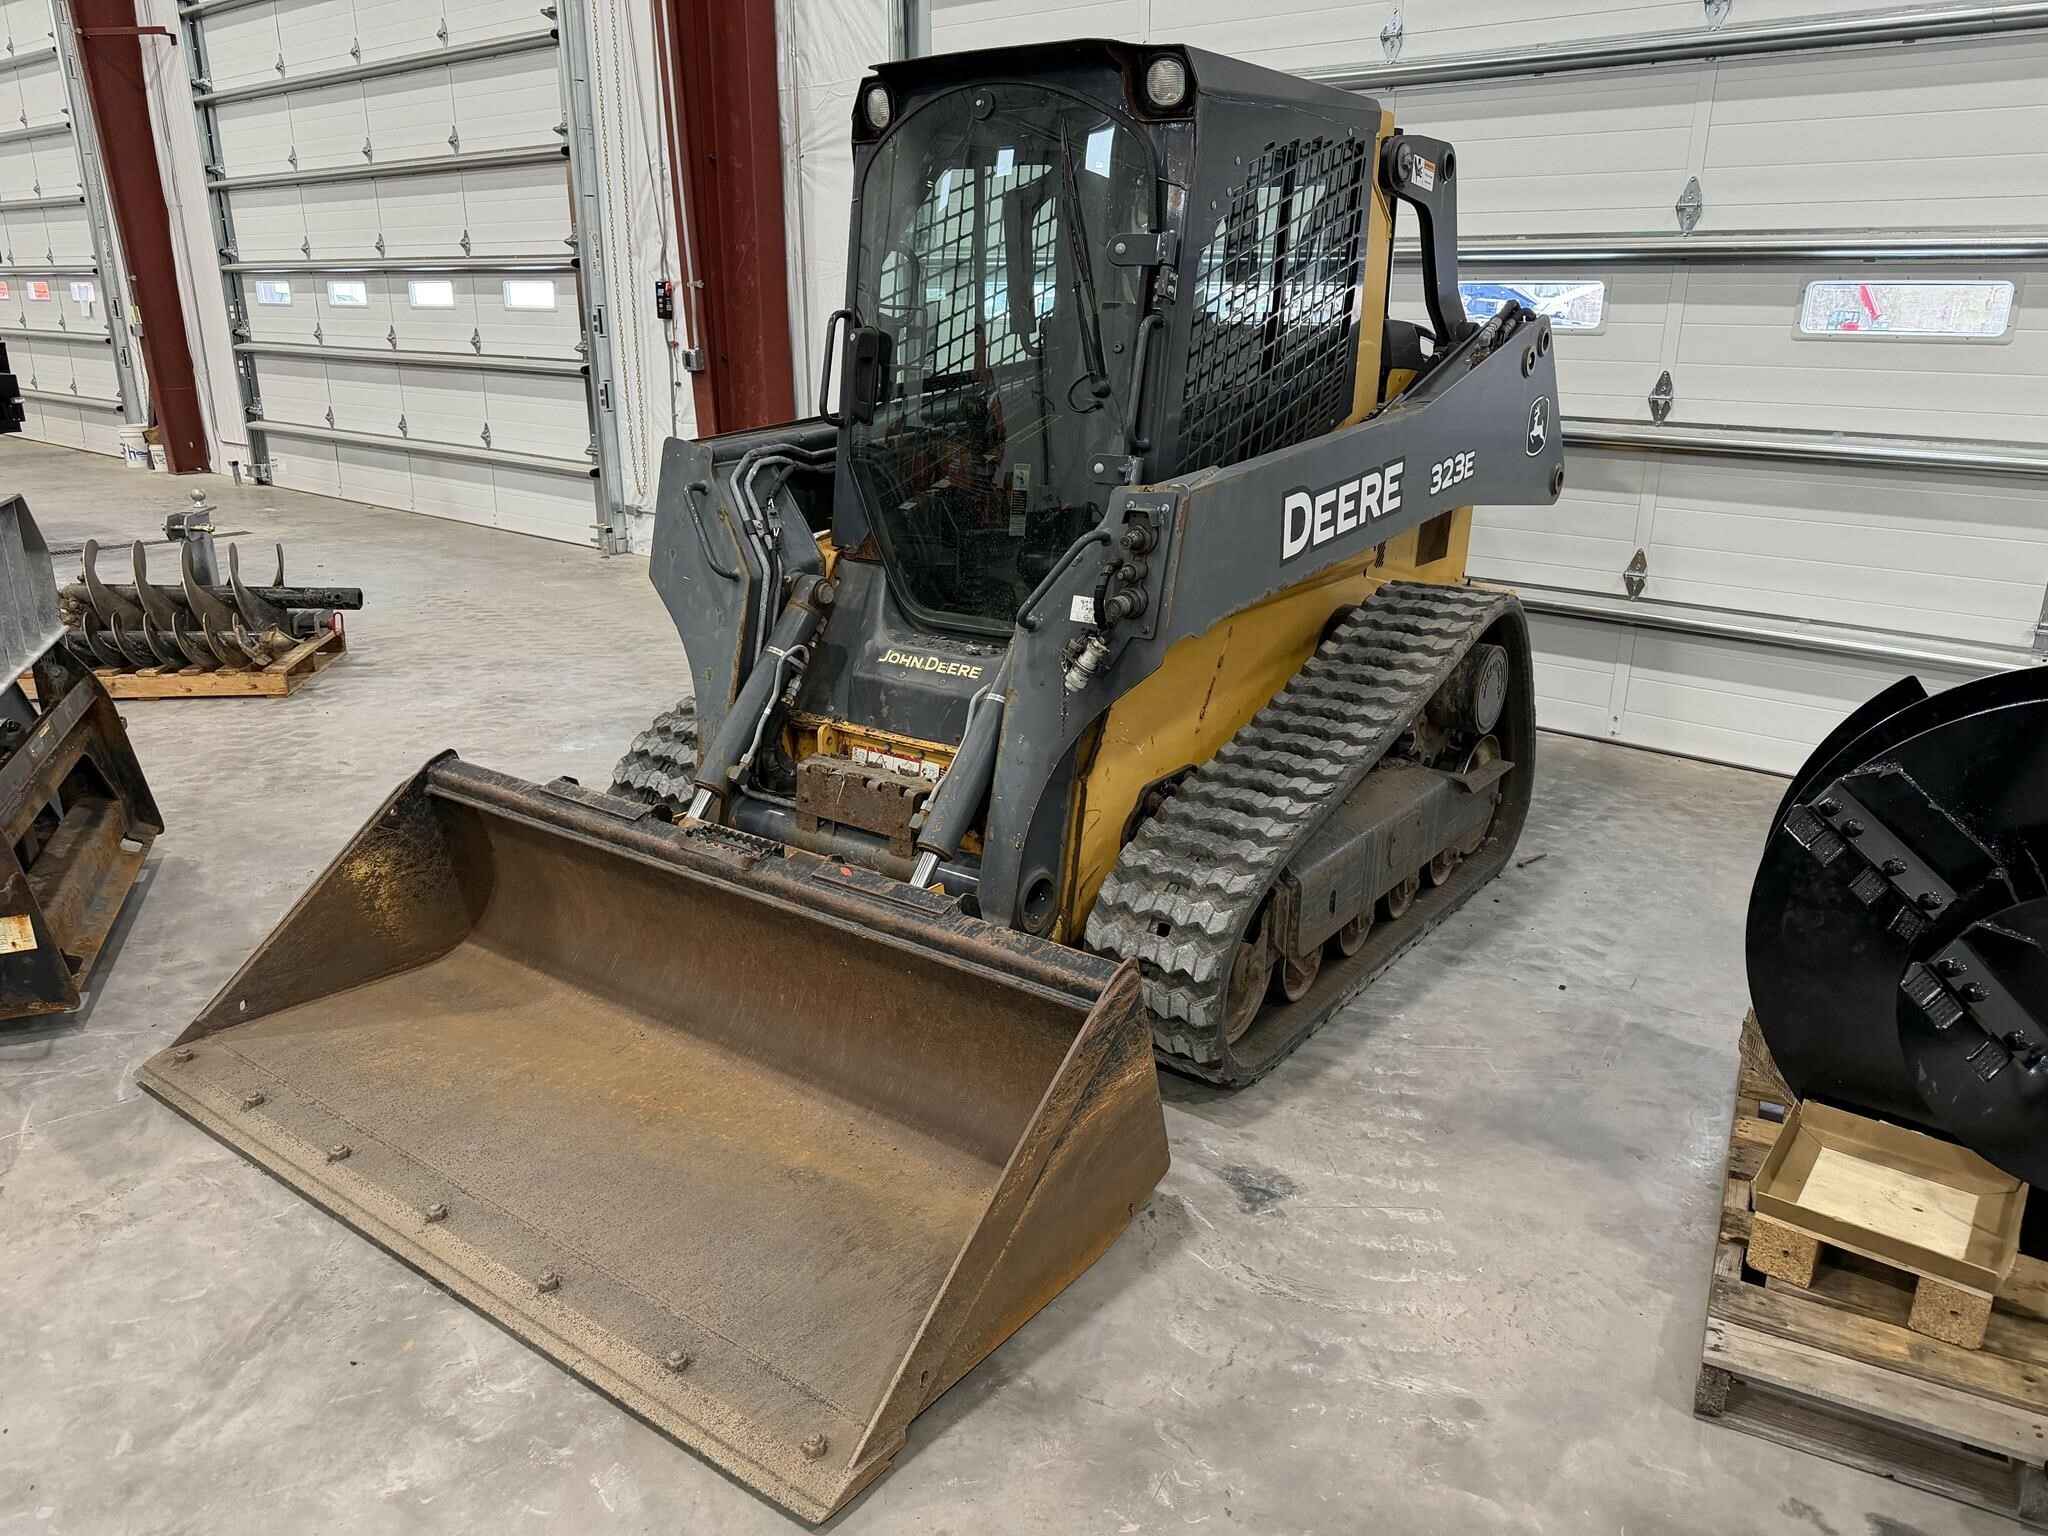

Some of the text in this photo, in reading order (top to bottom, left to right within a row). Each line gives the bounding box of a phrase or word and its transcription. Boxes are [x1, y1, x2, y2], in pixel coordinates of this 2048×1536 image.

[1430, 451, 1476, 495] 323E
[1282, 461, 1404, 561] DEERE
[878, 649, 984, 679] JOHN DEERE
